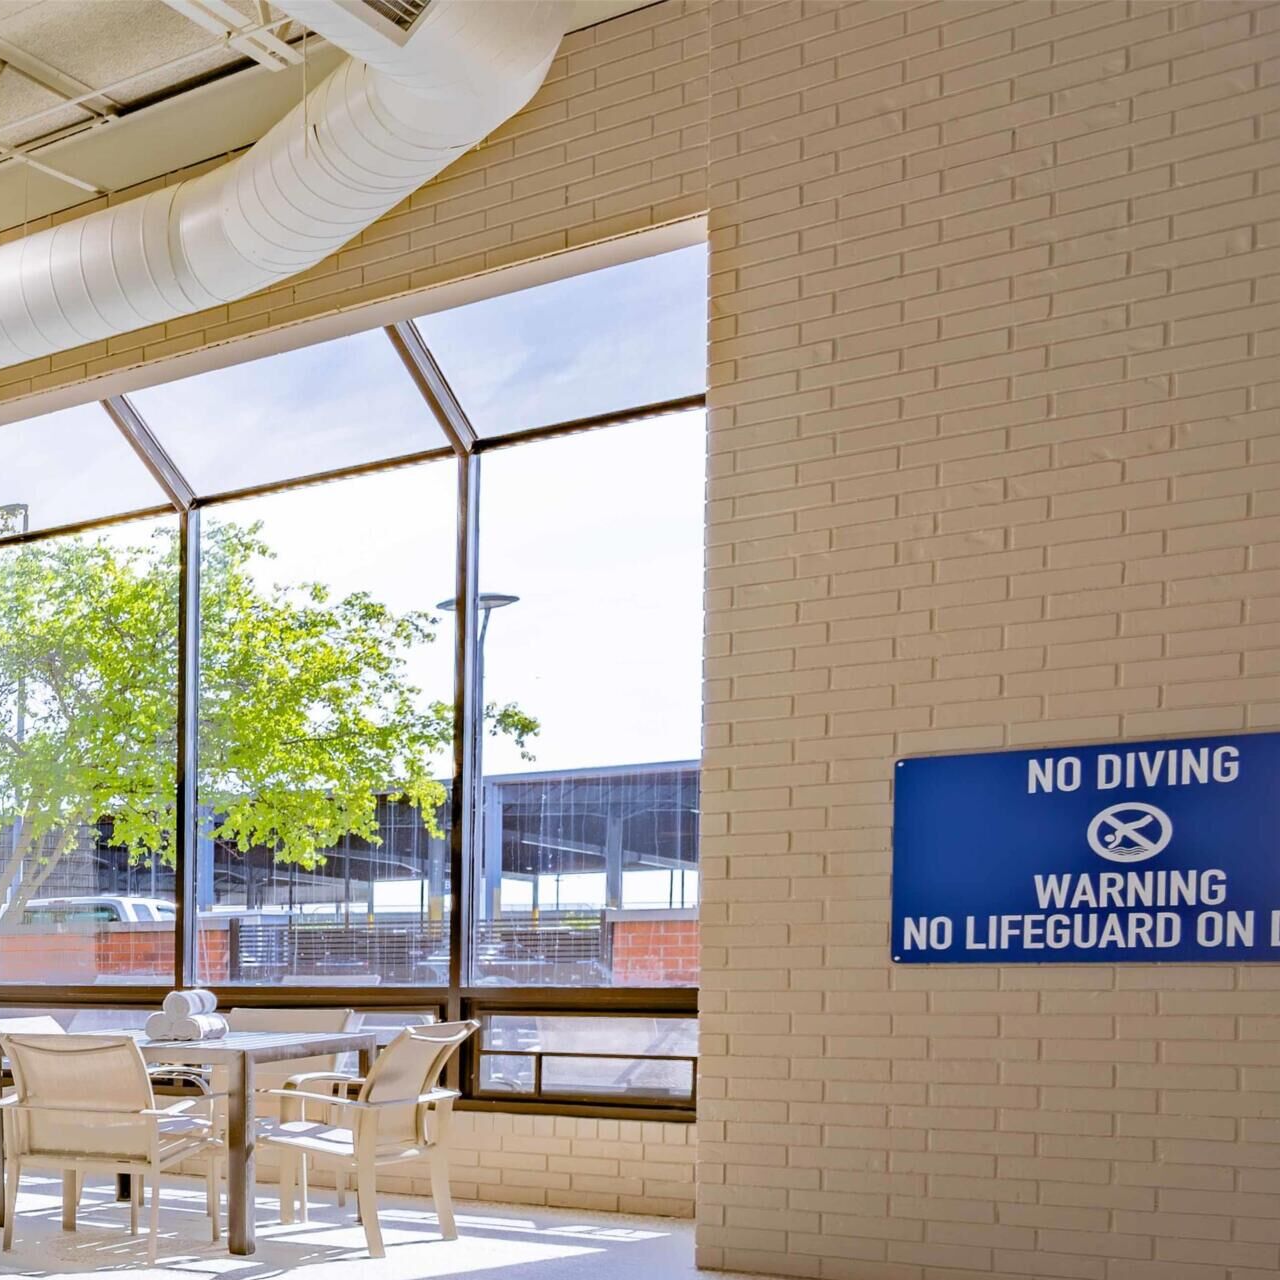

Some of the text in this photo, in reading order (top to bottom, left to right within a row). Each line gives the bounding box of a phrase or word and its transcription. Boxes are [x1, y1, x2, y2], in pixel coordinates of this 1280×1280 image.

[1028, 745, 1240, 794] NO DIVING
[1034, 869, 1227, 910] WARNING
[903, 916, 953, 951] NO
[965, 912, 1181, 950] LIFEGUARD
[1196, 911, 1255, 948] ON
